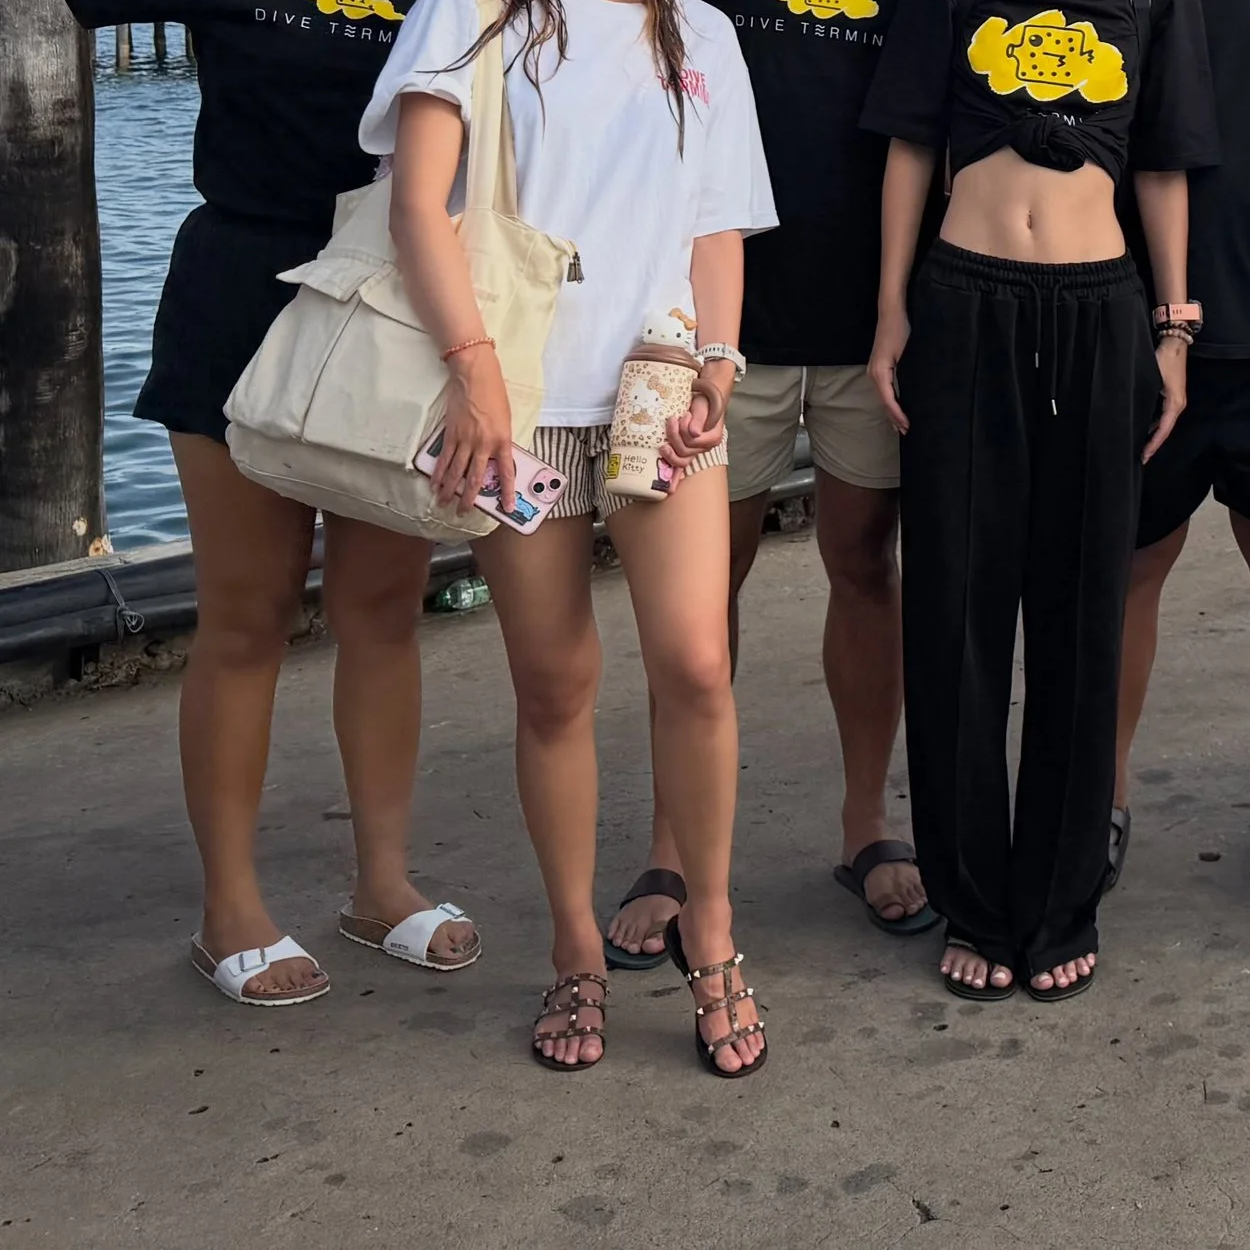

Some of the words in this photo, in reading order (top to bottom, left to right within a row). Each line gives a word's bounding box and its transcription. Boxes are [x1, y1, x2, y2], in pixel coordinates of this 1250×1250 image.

[255, 8, 312, 29] DIVE
[329, 22, 392, 43] TERM
[735, 14, 785, 32] DIVE
[801, 21, 883, 47] TERMIN
[622, 462, 645, 474] Kitty
[624, 454, 648, 464] Hello
